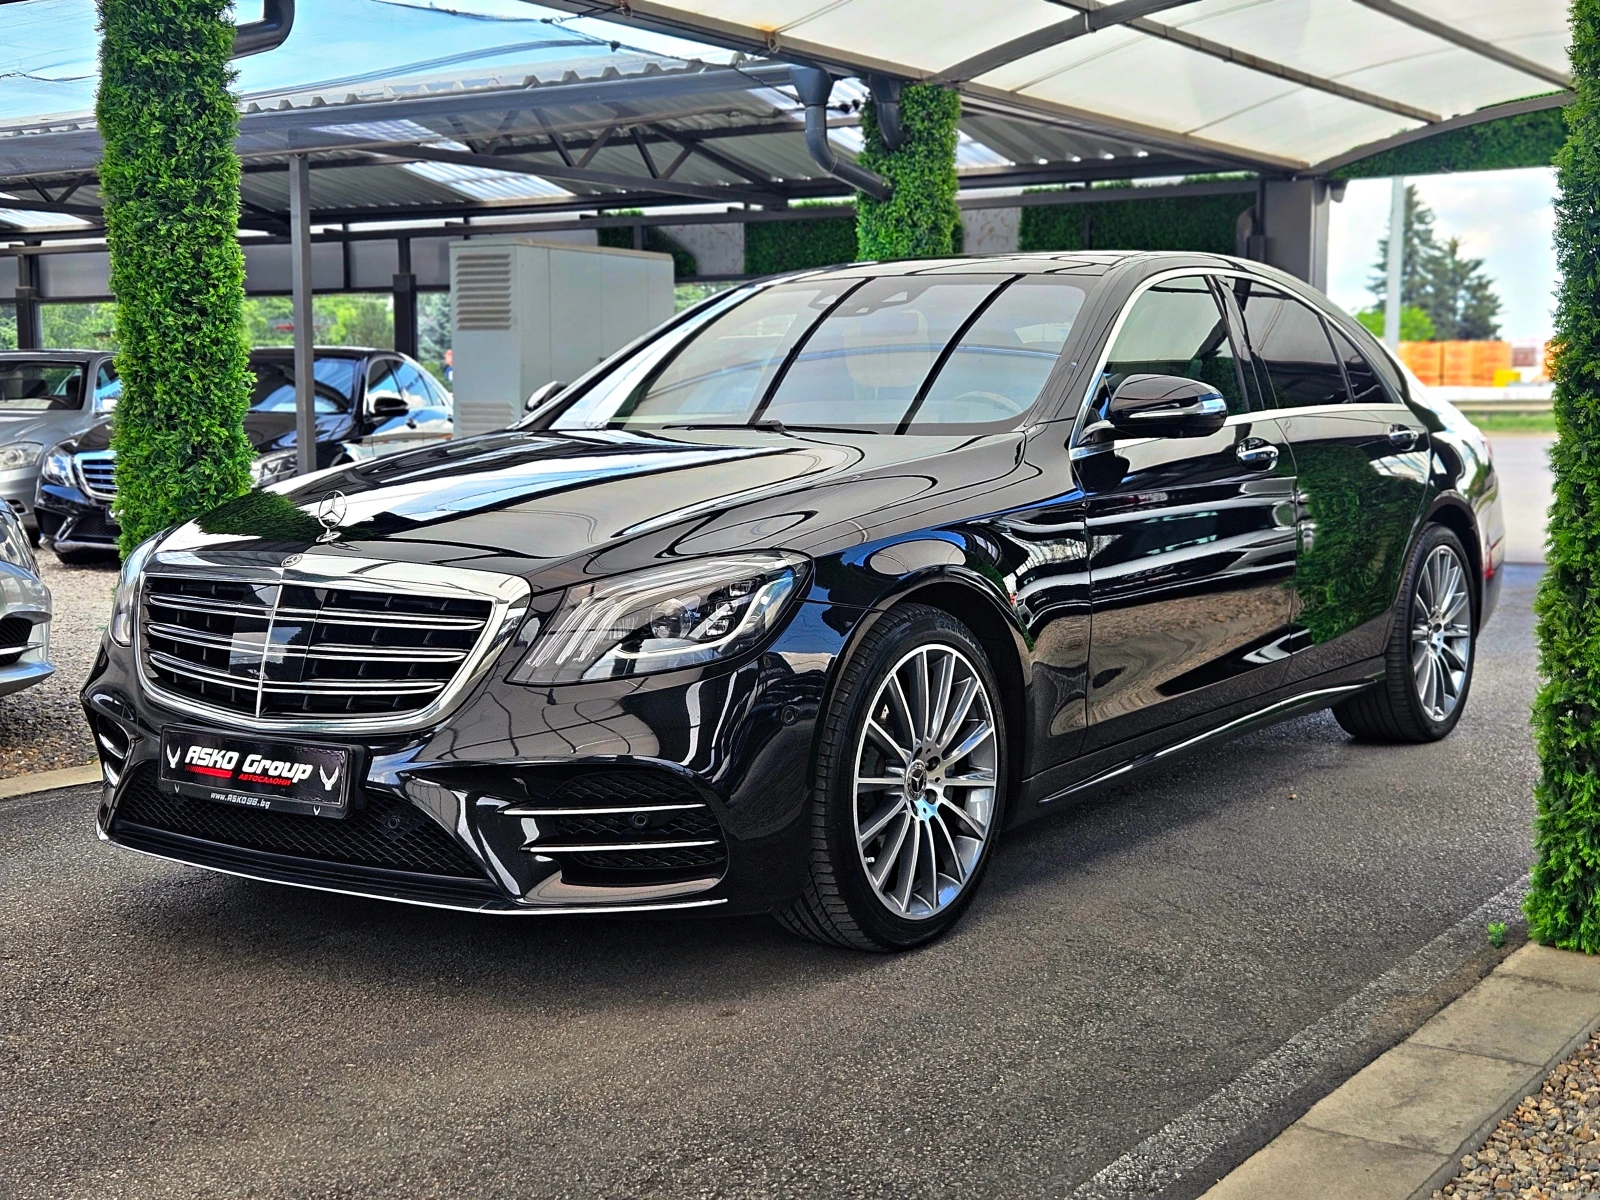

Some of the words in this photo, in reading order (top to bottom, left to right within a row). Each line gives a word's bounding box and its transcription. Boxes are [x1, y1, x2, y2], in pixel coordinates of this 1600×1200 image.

[184, 745, 239, 770] ASKO
[242, 754, 313, 783] Group
[238, 773, 292, 786] АВТОСАЛОНИ
